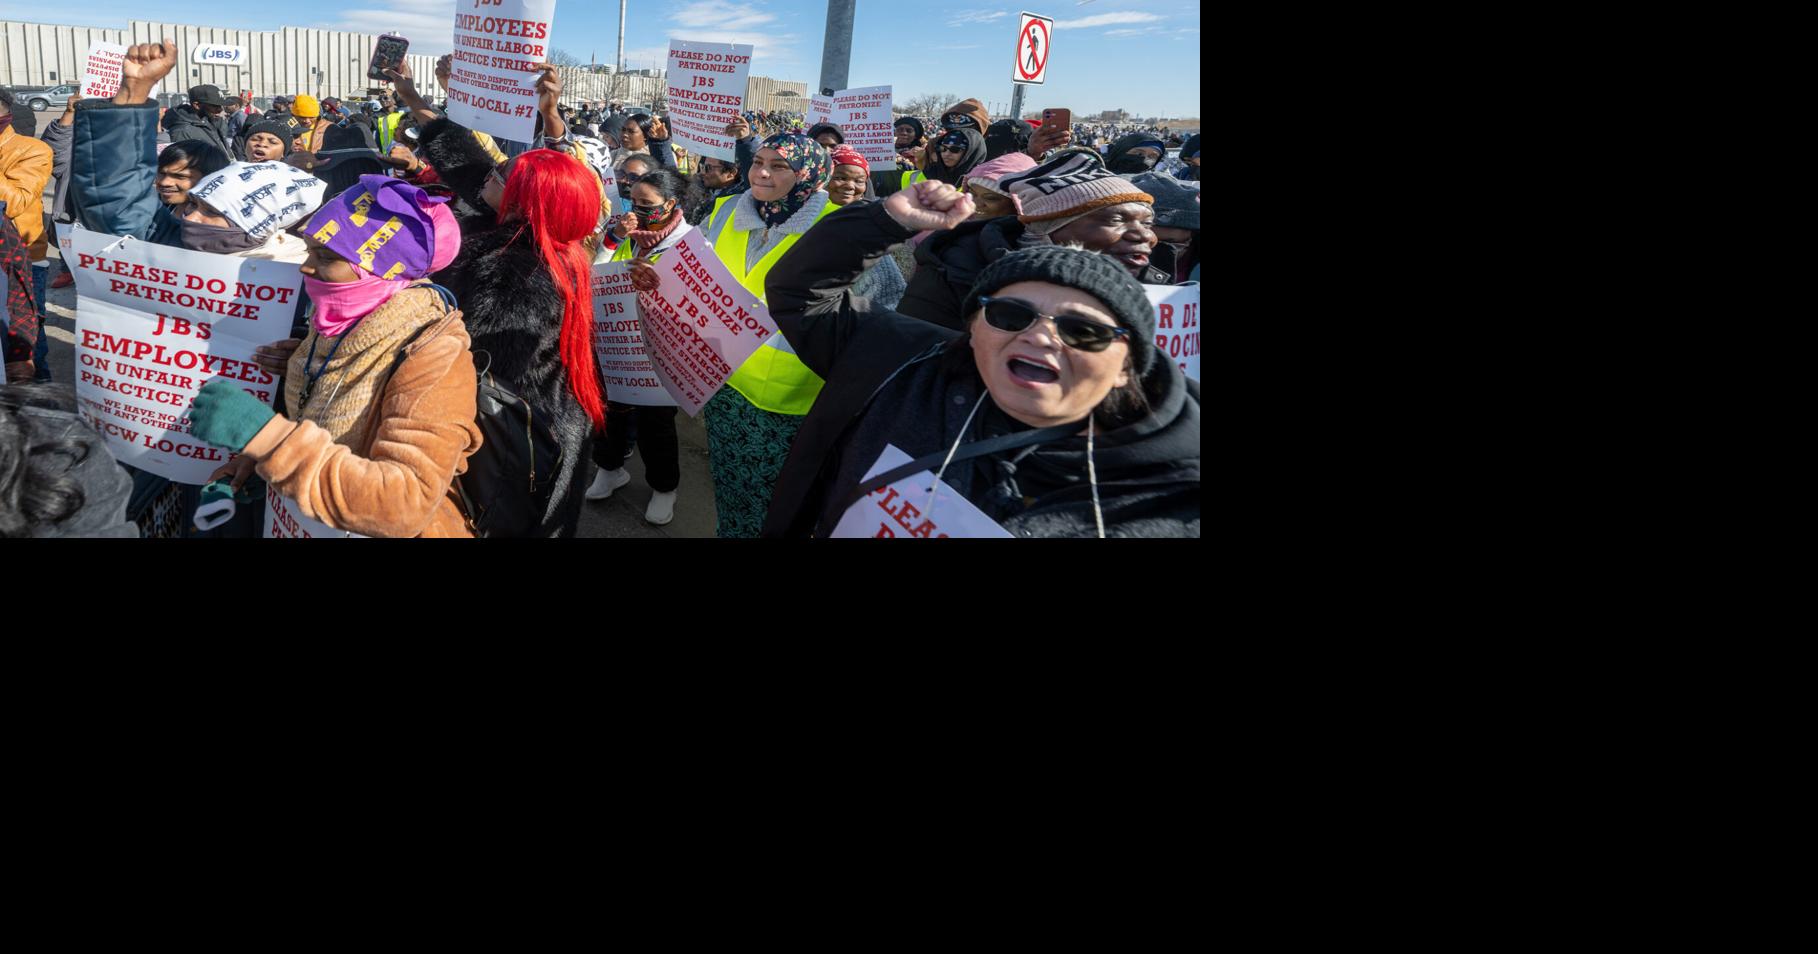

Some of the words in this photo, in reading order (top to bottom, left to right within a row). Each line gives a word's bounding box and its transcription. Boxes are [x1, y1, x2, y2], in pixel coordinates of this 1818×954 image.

[455, 13, 547, 39] EMPLOYEES
[103, 51, 125, 60] OCAL
[208, 50, 232, 59] JBS
[462, 35, 493, 51] UNFAIR
[496, 40, 544, 56] LABOR
[454, 49, 489, 66] RACTICE
[670, 49, 704, 61] PLEASE
[706, 53, 722, 62] DO
[725, 54, 750, 64] NOT
[678, 60, 736, 73] PATRONIZE
[86, 67, 119, 79] INJUSTAS
[478, 73, 487, 81] NO
[488, 76, 519, 86] DISPUTE
[692, 75, 715, 87] JBS
[90, 82, 106, 90] POR
[470, 79, 490, 89] OTHER
[490, 83, 534, 97] EMPLOYER
[669, 87, 742, 106] EMPLOYEES
[448, 88, 469, 104] UFCW
[471, 94, 512, 115] LOCAL
[515, 104, 534, 118] #7
[669, 106, 707, 120] PRACTICE
[680, 100, 708, 112] UNFAIR
[710, 105, 740, 115] LABOR
[841, 122, 892, 131] PLOYEES
[849, 112, 868, 121] JBS
[692, 134, 721, 147] LOCAL
[723, 141, 734, 149] #7
[78, 253, 178, 287] PLEASE
[184, 274, 226, 294] DO
[233, 282, 294, 304] NOT
[606, 274, 620, 284] DO
[675, 239, 713, 287] PLEASE
[710, 283, 734, 308] DO
[733, 306, 770, 339] NOT
[110, 279, 260, 320] PATRONIZE
[603, 302, 624, 316] JBS
[672, 262, 743, 337] PATRONIZE
[676, 295, 709, 328] JBS
[1182, 303, 1197, 328] DE
[152, 313, 212, 340] JBS
[638, 291, 652, 307] ON
[651, 307, 686, 346] UNFAIR
[687, 342, 724, 383] LABOR
[647, 288, 732, 375] MPLOYEES
[81, 329, 274, 385] EMPLOYEES
[80, 353, 108, 371] ON
[115, 362, 193, 389] UNFAIR
[652, 350, 685, 391] LOCAL
[685, 391, 702, 406] #7
[678, 350, 718, 389] STRIKE
[80, 370, 183, 407] PRACTICE
[624, 377, 659, 387] LOCAL
[104, 398, 121, 409] WE
[124, 404, 155, 418] HAVE
[158, 413, 177, 422] NO
[114, 410, 138, 421] ANY
[141, 417, 182, 432] OTHER
[143, 435, 222, 461] LOCAL
